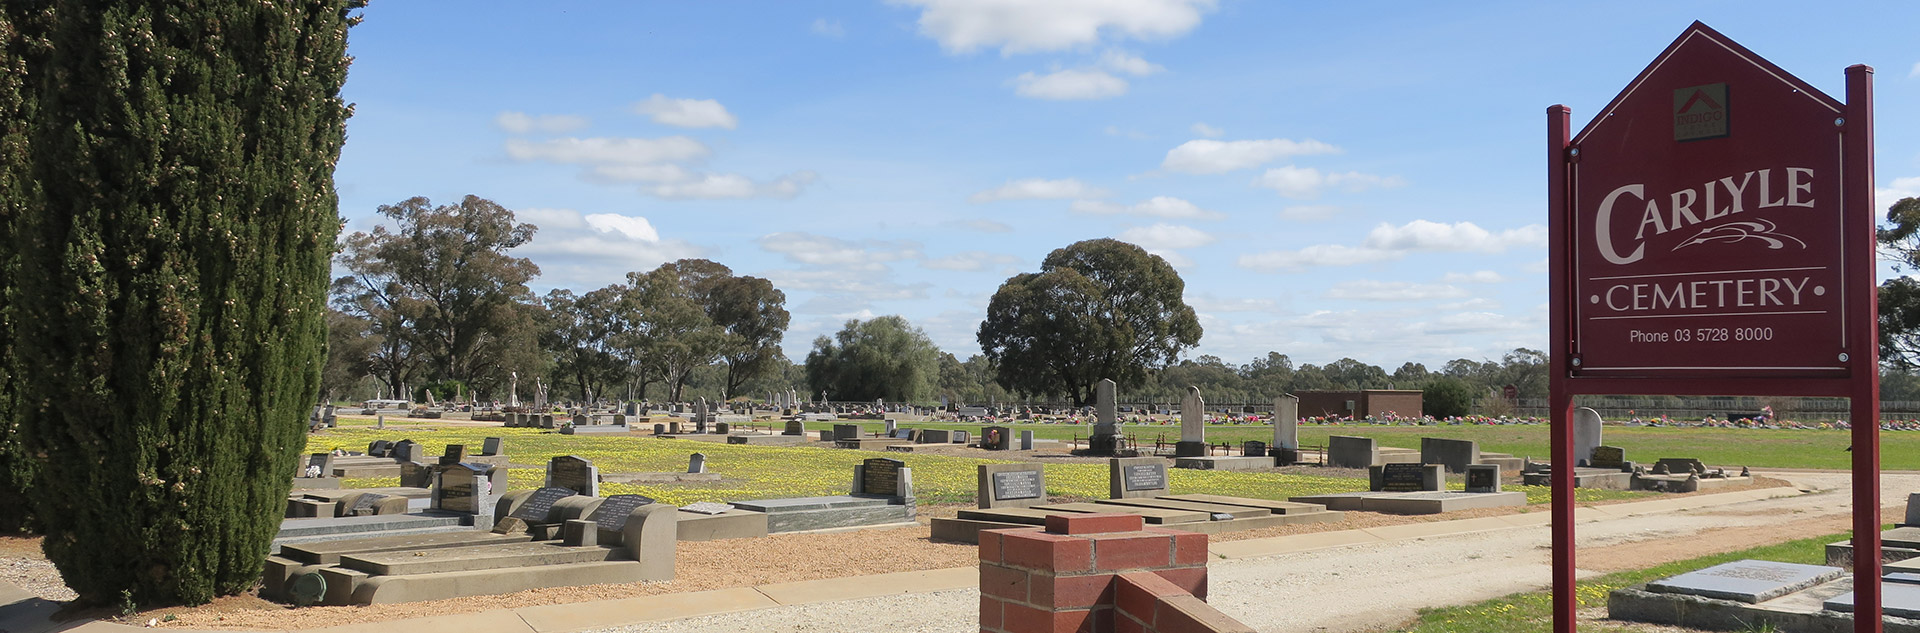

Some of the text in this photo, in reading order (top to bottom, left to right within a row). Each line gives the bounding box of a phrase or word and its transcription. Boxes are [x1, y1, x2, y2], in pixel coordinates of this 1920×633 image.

[1677, 110, 1723, 125] INDIGO
[1595, 167, 1816, 265] CARLYLE
[1605, 277, 1810, 311] CEMETERY
[1630, 327, 1773, 342] Phone 03 5728 8000
